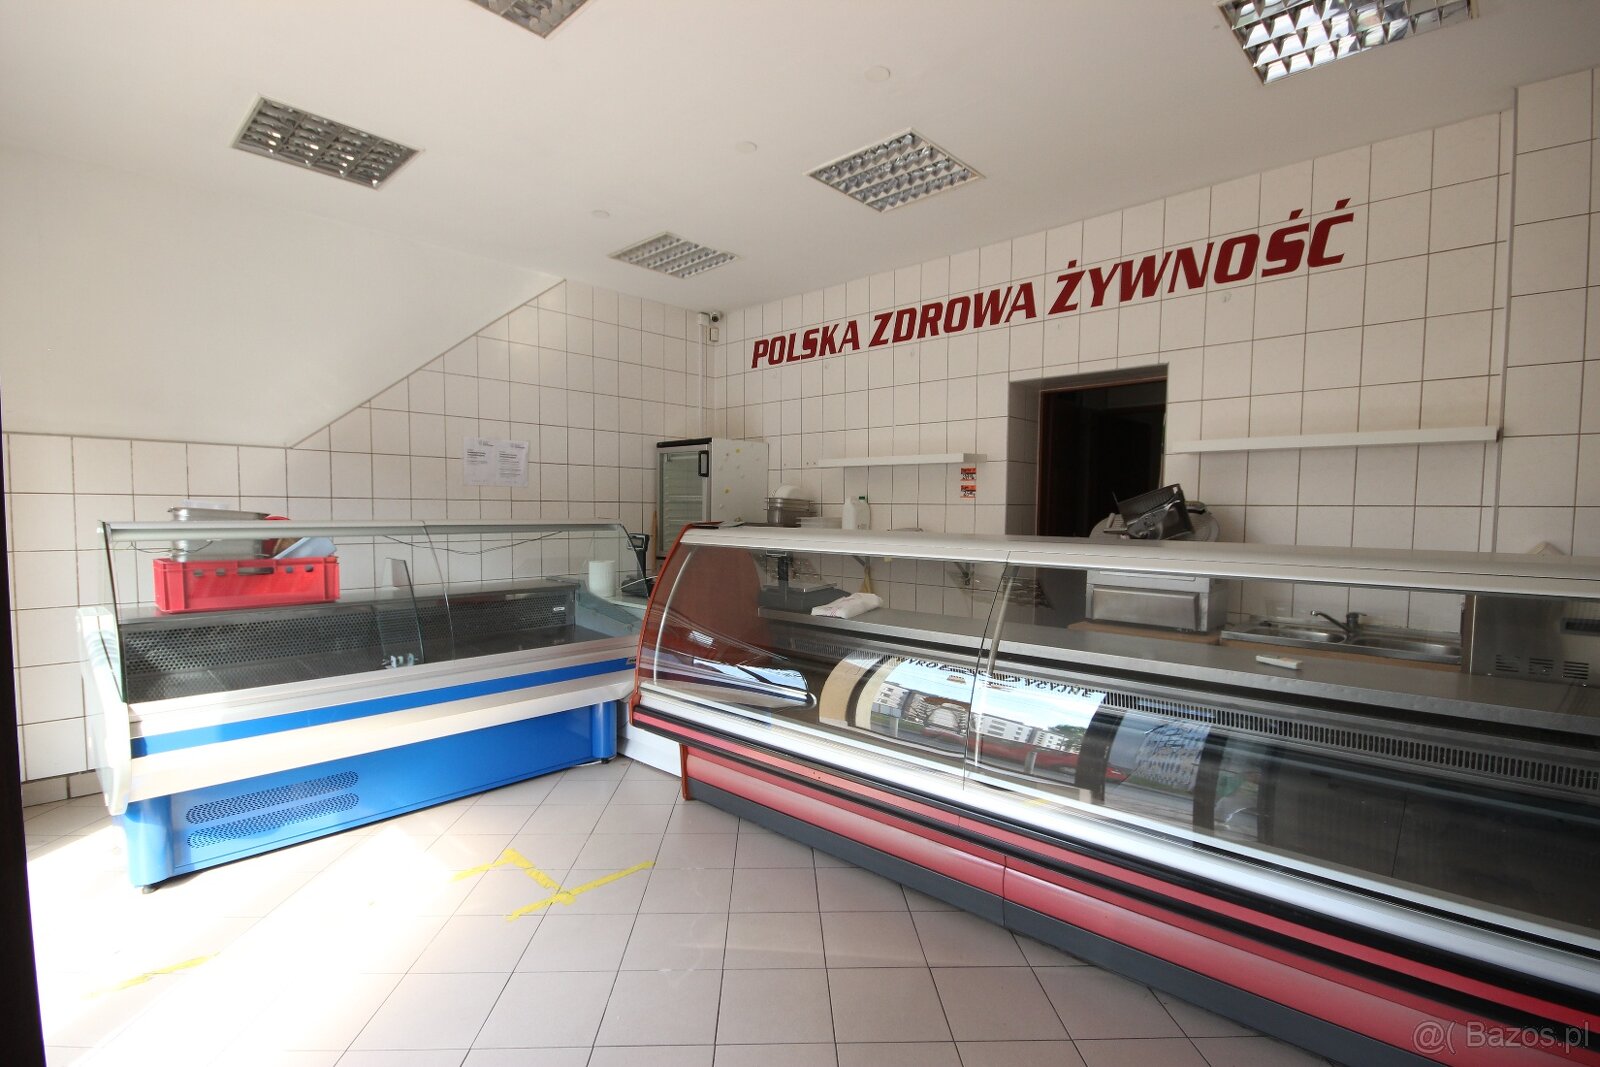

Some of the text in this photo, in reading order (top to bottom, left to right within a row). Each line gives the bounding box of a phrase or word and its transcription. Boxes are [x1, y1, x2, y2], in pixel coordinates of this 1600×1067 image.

[751, 198, 1354, 369] POLSKA ZDROWA ŻYWNOŚĆ
